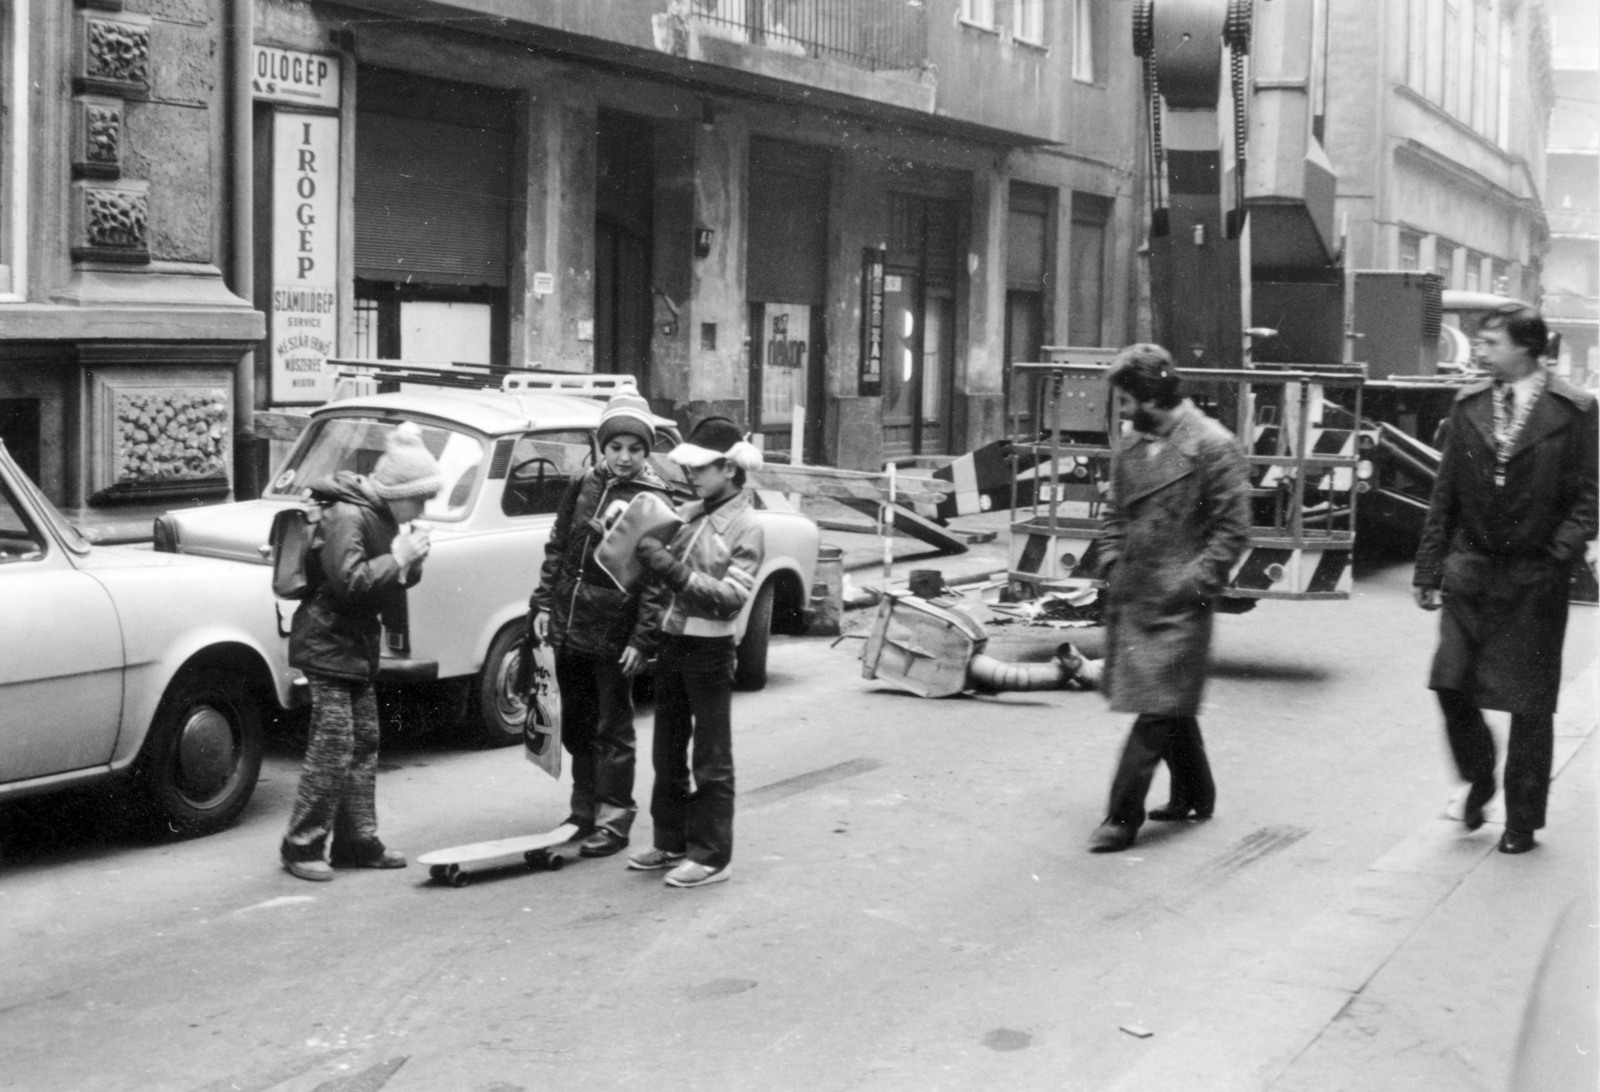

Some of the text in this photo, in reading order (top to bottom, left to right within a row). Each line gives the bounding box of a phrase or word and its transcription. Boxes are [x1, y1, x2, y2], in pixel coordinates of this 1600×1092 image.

[253, 49, 328, 87] OLÓGÉP
[274, 286, 334, 314] SZÁMOLÓGÉP
[287, 317, 321, 328] SERVICE
[285, 354, 321, 372] MŰSZERÉS
